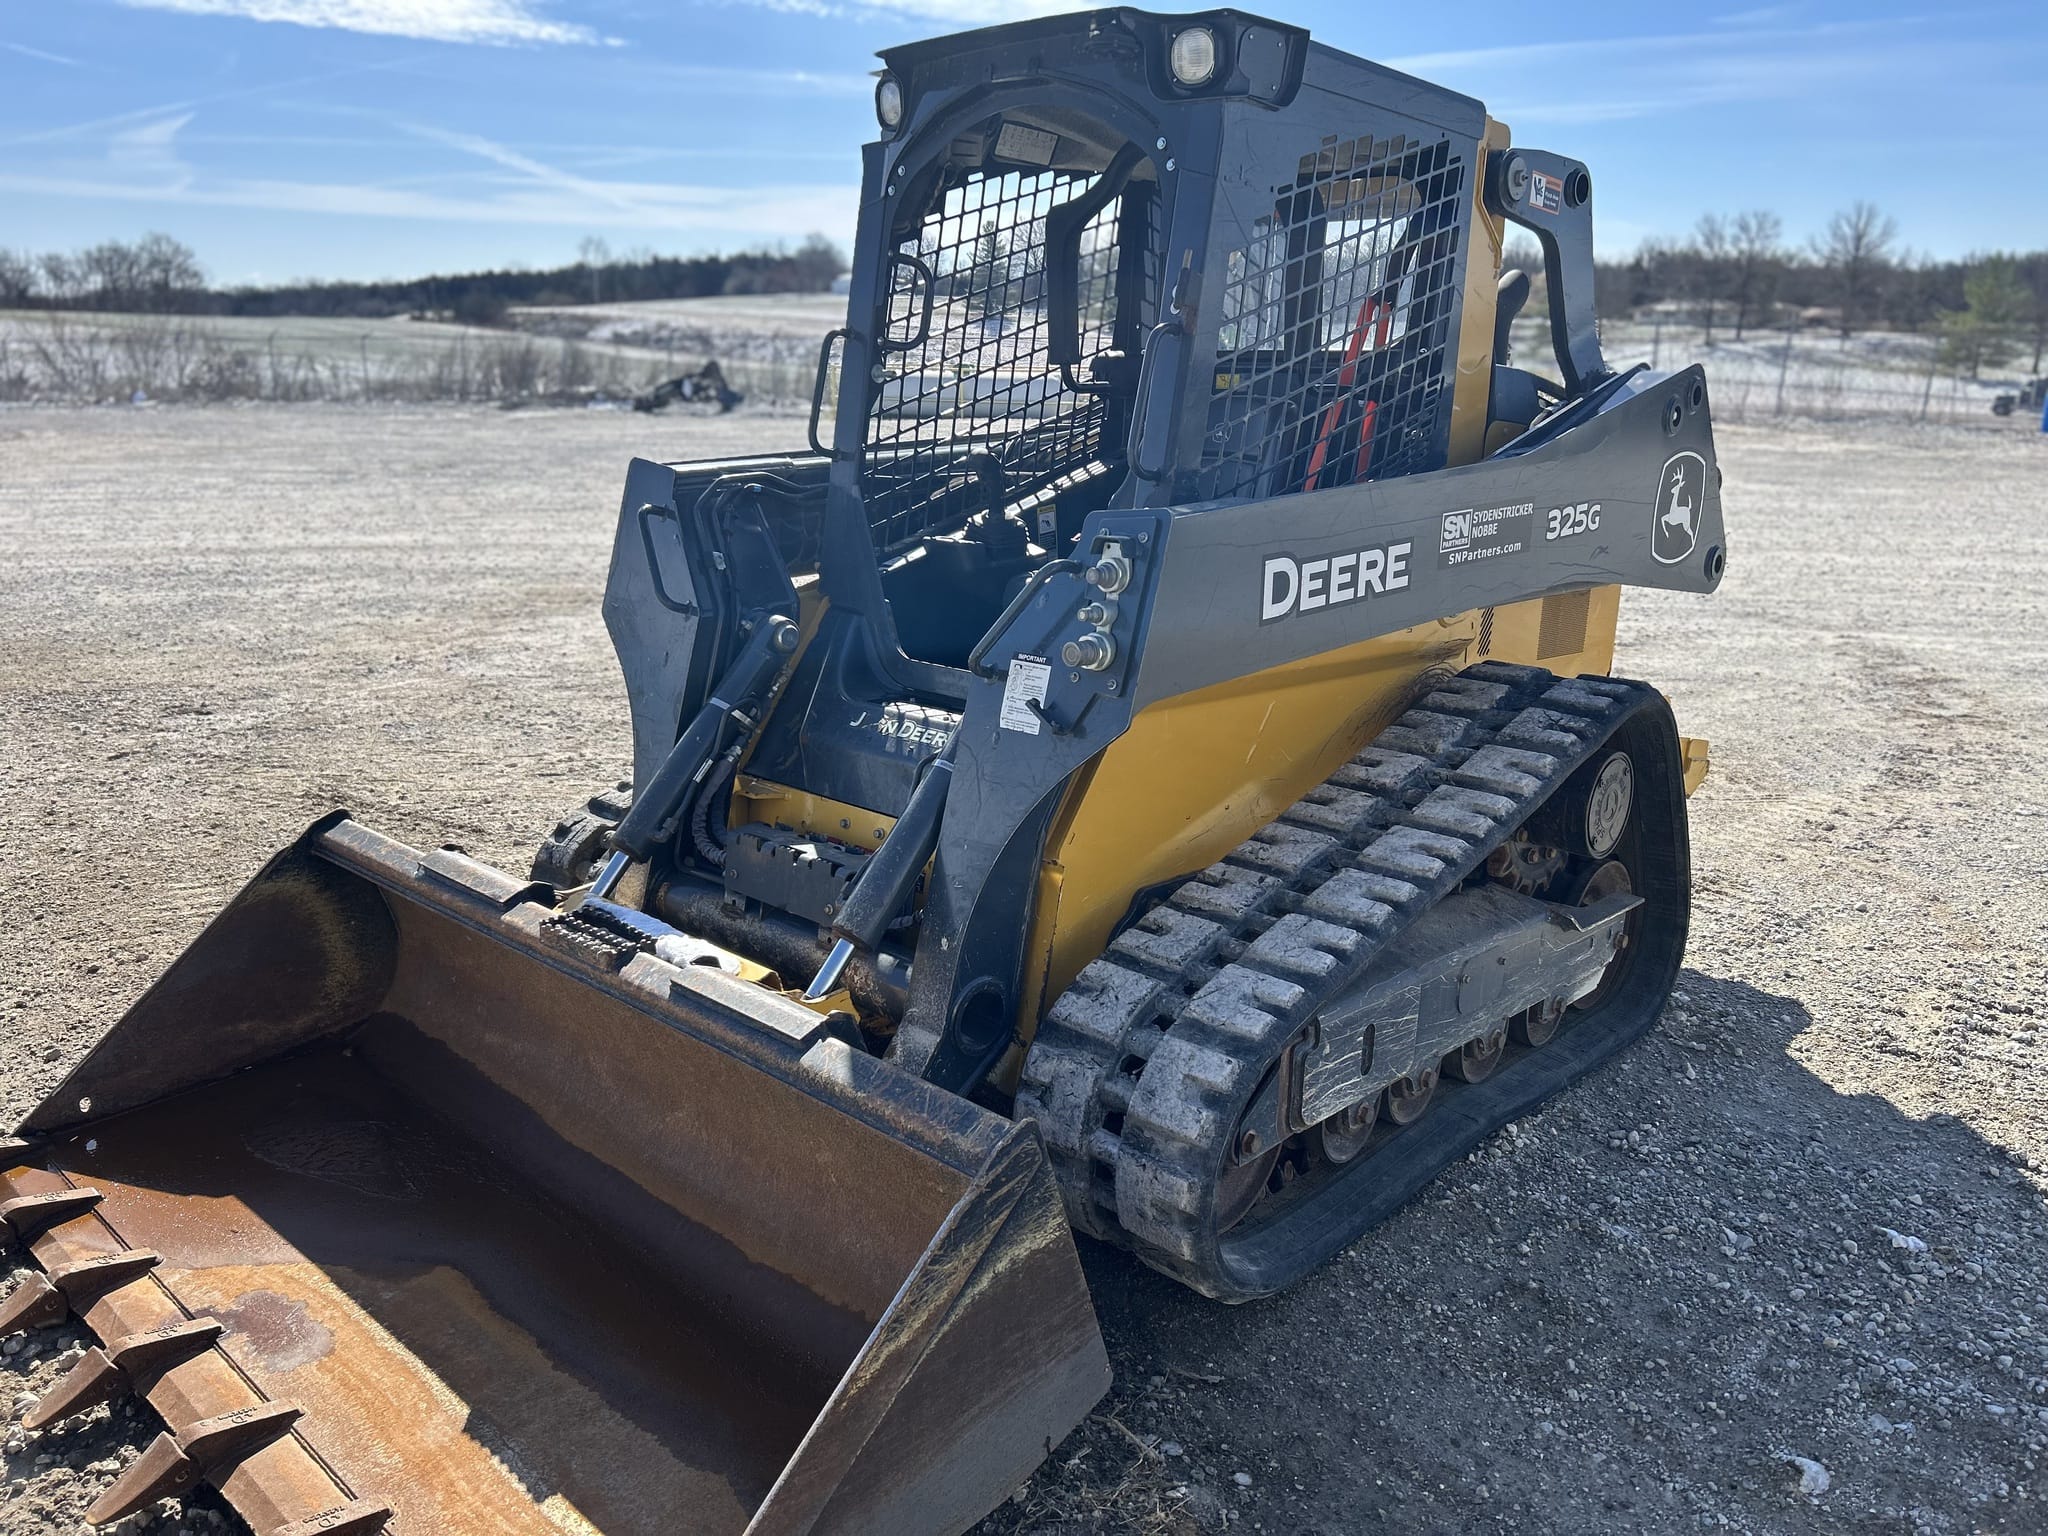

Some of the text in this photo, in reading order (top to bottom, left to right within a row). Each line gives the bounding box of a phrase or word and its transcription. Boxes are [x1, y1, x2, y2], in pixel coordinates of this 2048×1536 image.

[1473, 503, 1533, 524] SYDENSTRICKER
[1545, 503, 1600, 540] 325G
[1444, 514, 1470, 540] SN
[1471, 523, 1498, 539] NOBBE
[1442, 537, 1468, 549] PARTNERS
[1448, 542, 1521, 565] SNPartners.com
[1262, 542, 1411, 620] DEERE
[1018, 653, 1046, 664] IMPORTANT
[897, 719, 951, 747] DEER
